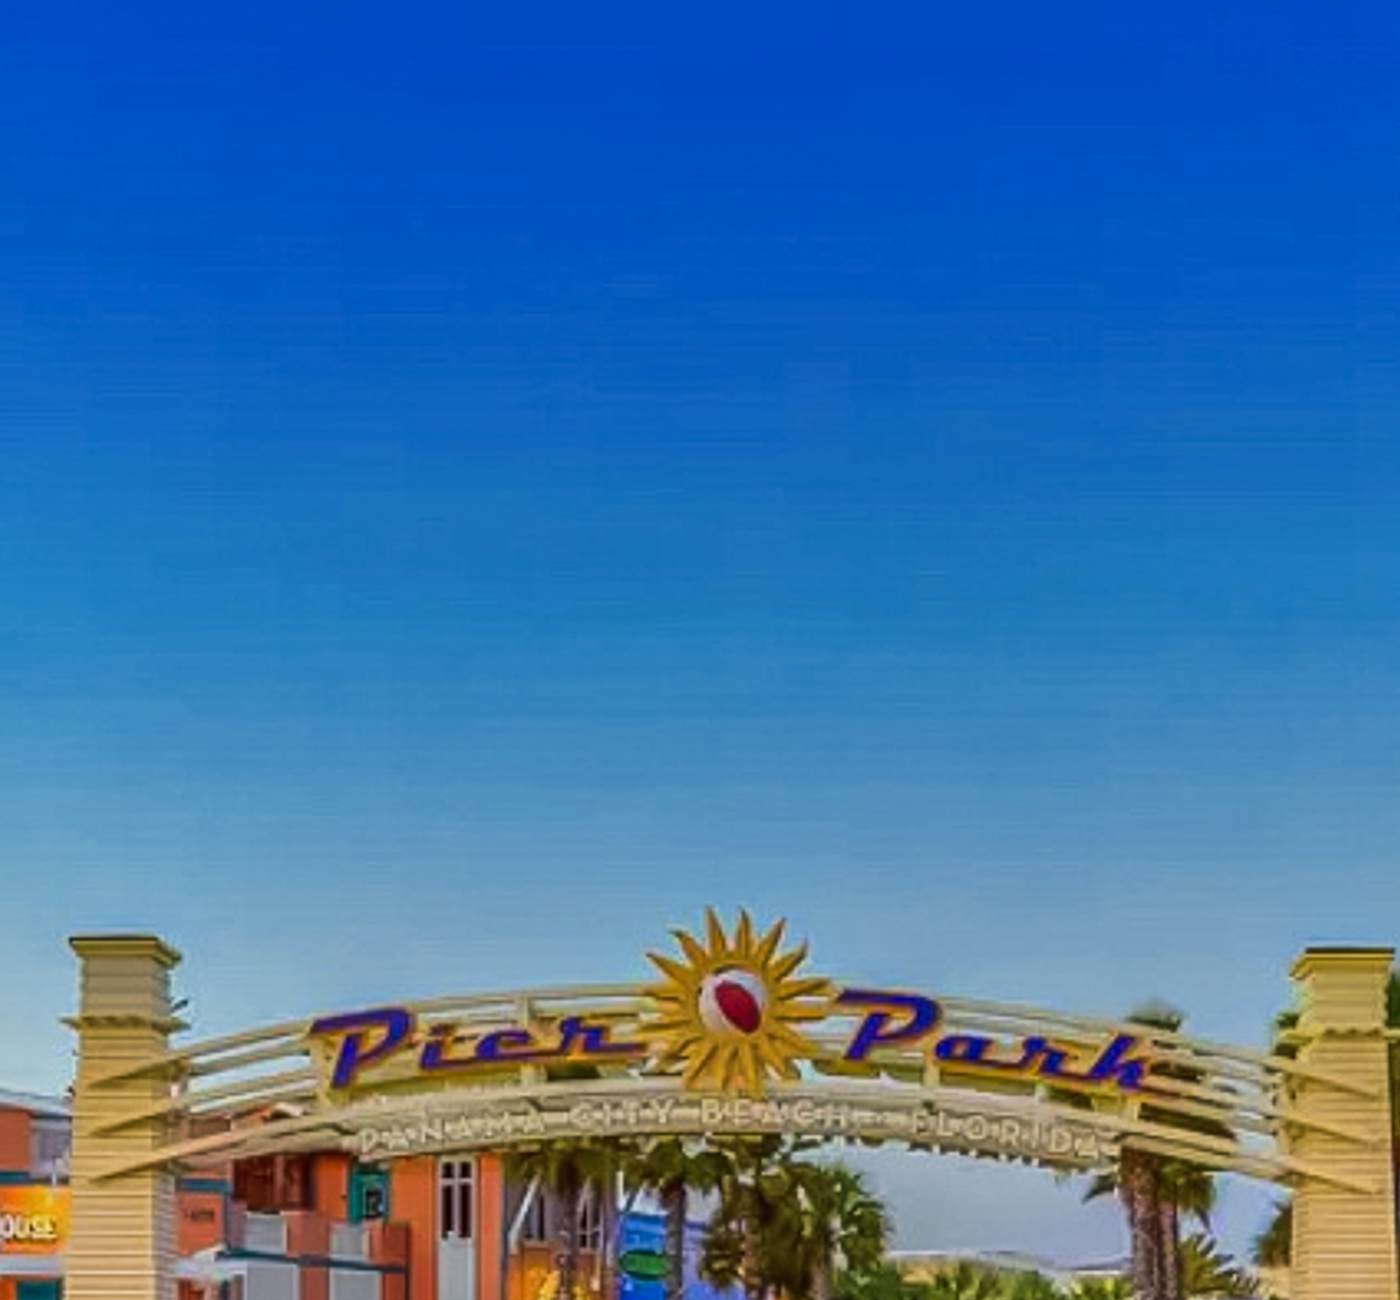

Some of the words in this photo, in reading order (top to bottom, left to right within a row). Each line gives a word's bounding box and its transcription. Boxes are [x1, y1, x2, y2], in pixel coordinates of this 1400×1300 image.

[308, 1005, 648, 1090] Pier
[836, 988, 1158, 1091] Park
[569, 1097, 674, 1128] CITY
[701, 1097, 850, 1128] BEACH
